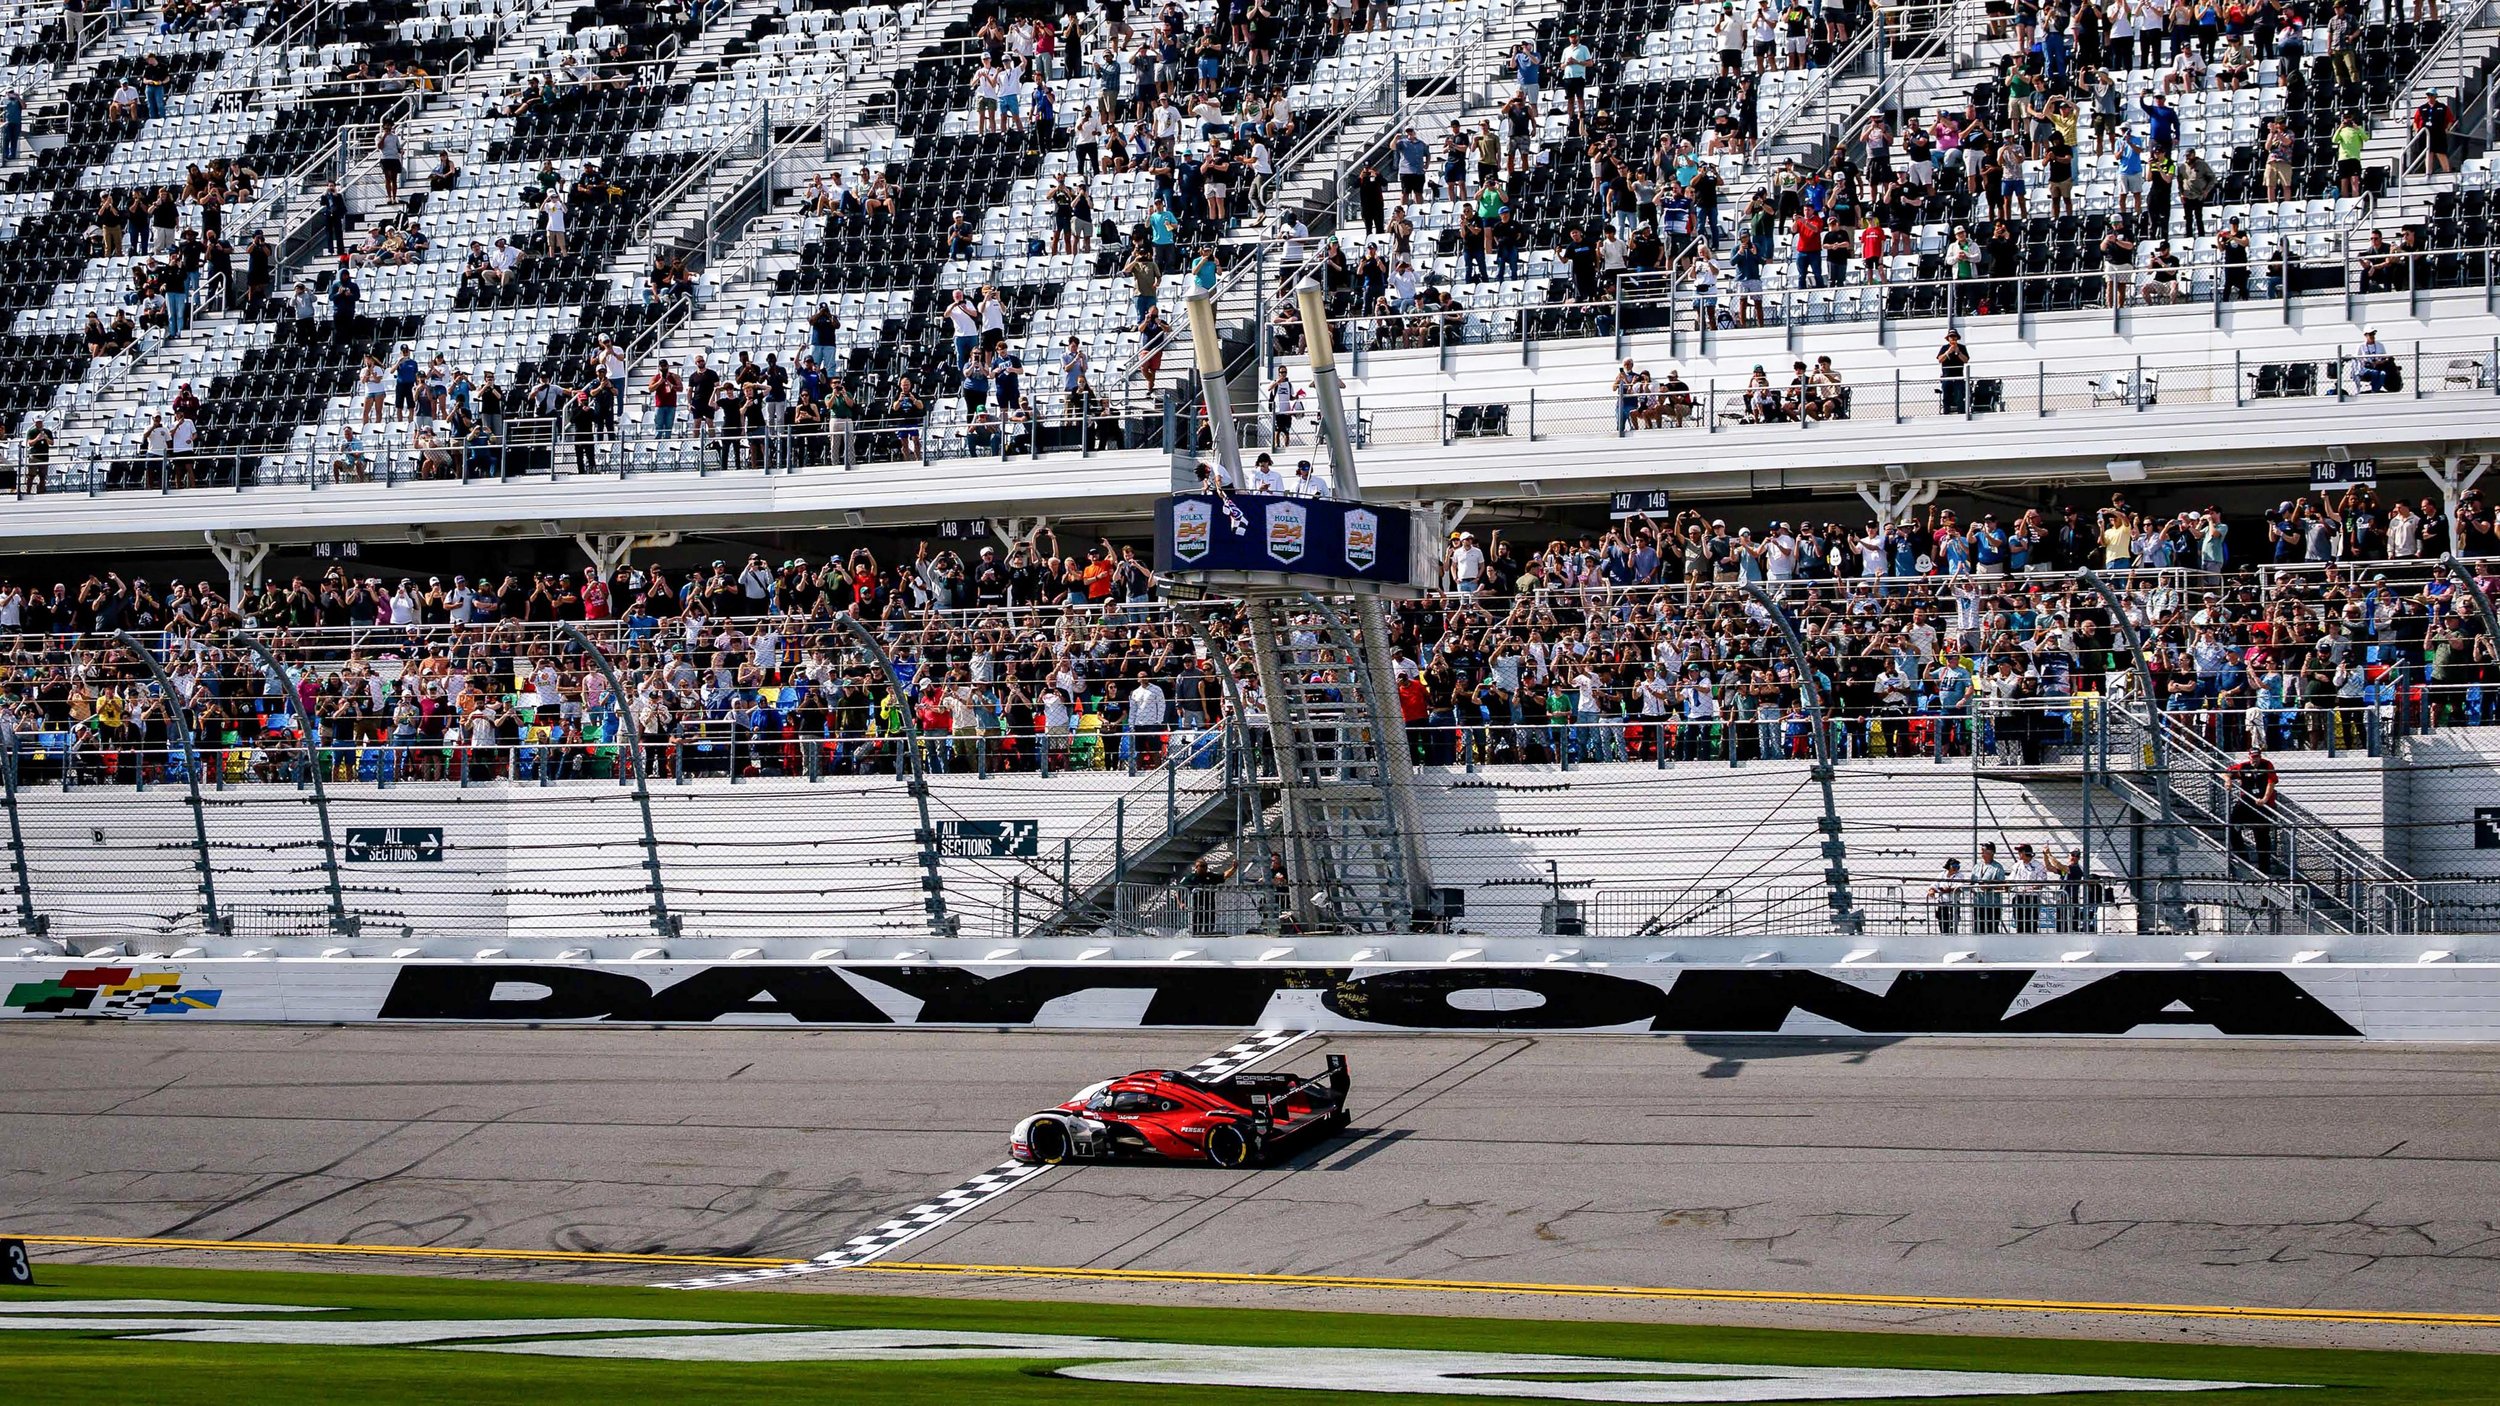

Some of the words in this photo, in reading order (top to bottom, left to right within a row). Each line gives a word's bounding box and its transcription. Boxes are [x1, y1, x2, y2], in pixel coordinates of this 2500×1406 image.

[638, 65, 666, 87] 354
[218, 93, 243, 114] 355
[2316, 463, 2336, 479] 146
[2353, 462, 2373, 478] 145
[1615, 493, 1632, 509] 147
[1648, 492, 1666, 508] 146
[941, 521, 958, 536] 148
[970, 521, 986, 535] 147
[1177, 522, 1207, 537] 24
[1271, 523, 1302, 539] 24
[1348, 531, 1374, 546] 24
[315, 542, 331, 557] 149
[342, 542, 358, 556] 148
[94, 831, 104, 842] D
[384, 828, 403, 845] ALL
[942, 821, 961, 839] ALL
[368, 845, 418, 861] SECTIONS
[940, 839, 992, 856] SECTIONS
[377, 965, 2366, 1037] DAYTONA
[1079, 1142, 1087, 1155] 7
[9, 1245, 29, 1280] 3
